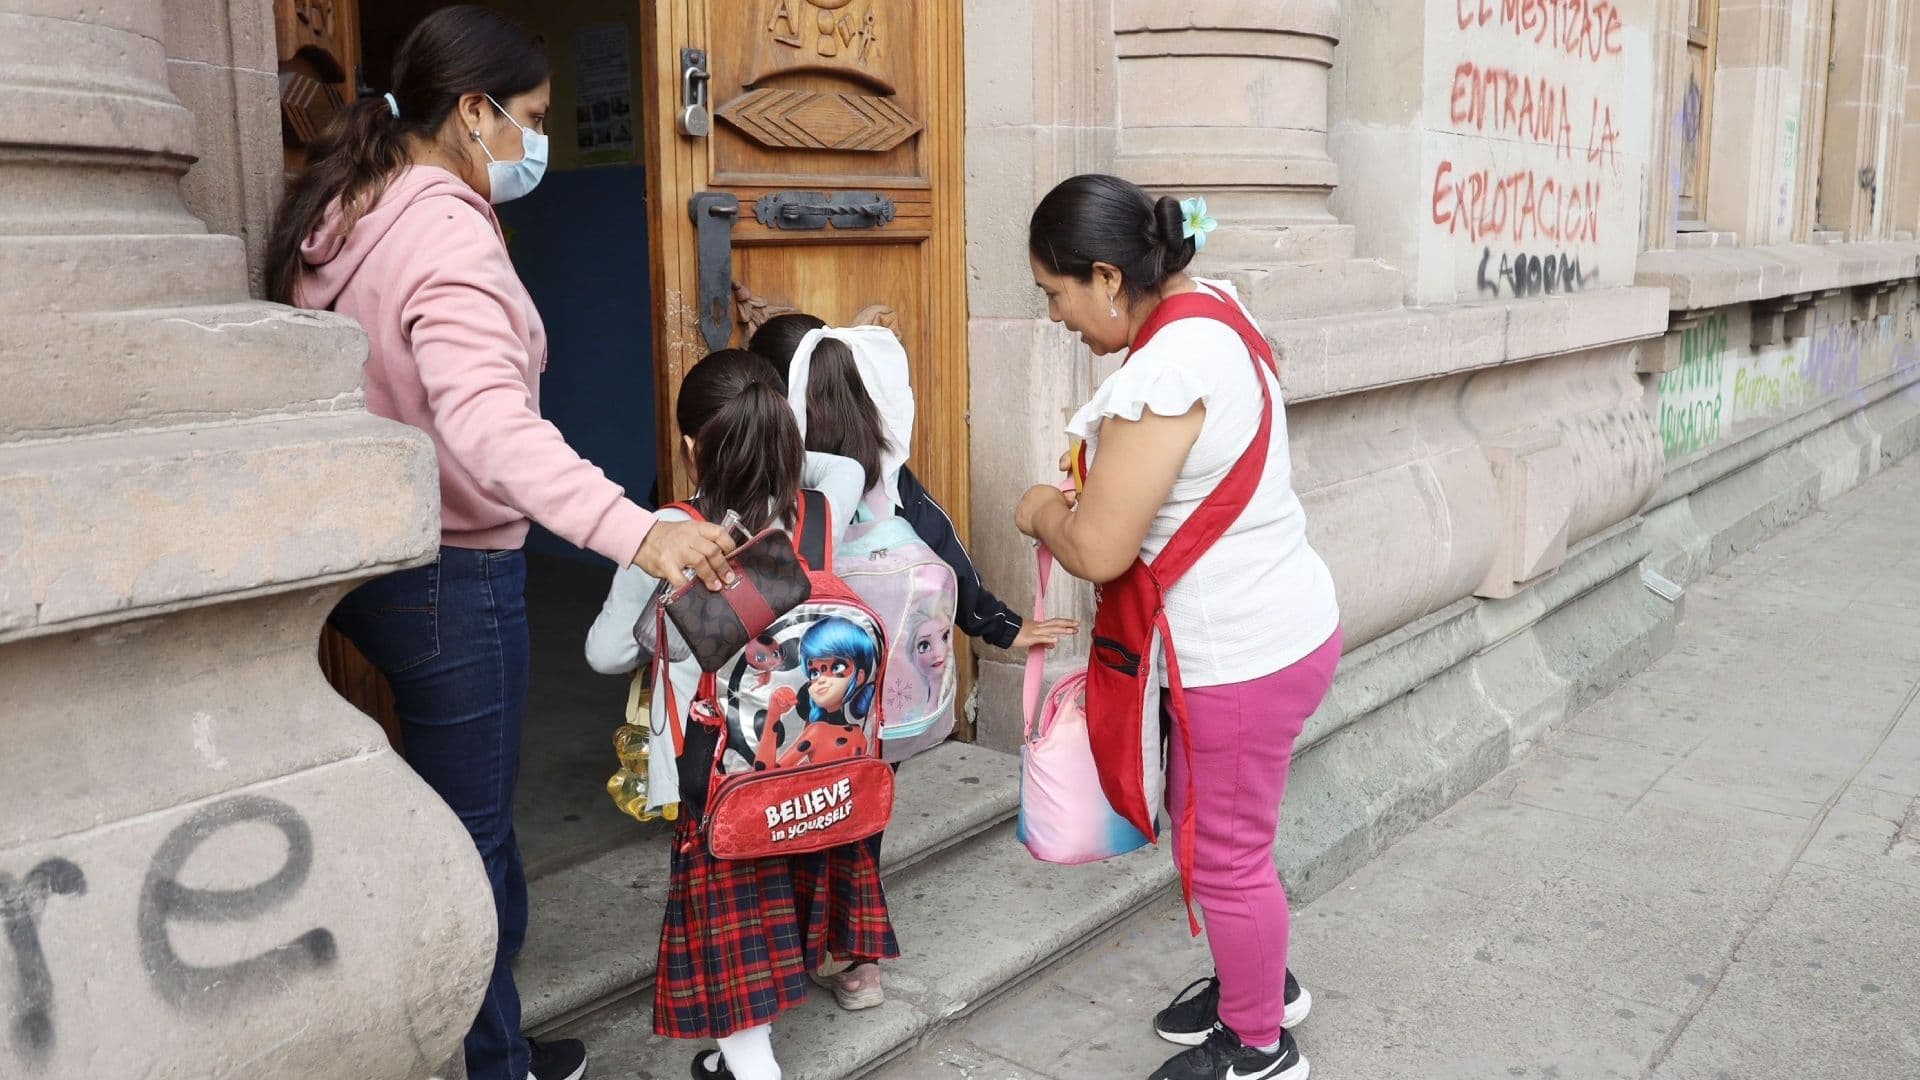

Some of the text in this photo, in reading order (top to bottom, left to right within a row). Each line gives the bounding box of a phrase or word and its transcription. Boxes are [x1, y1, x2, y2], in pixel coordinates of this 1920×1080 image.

[1587, 97, 1620, 172] LA
[1432, 160, 1601, 243] EXPLOTACION
[764, 777, 851, 829] BELIEVE
[771, 830, 786, 842] in
